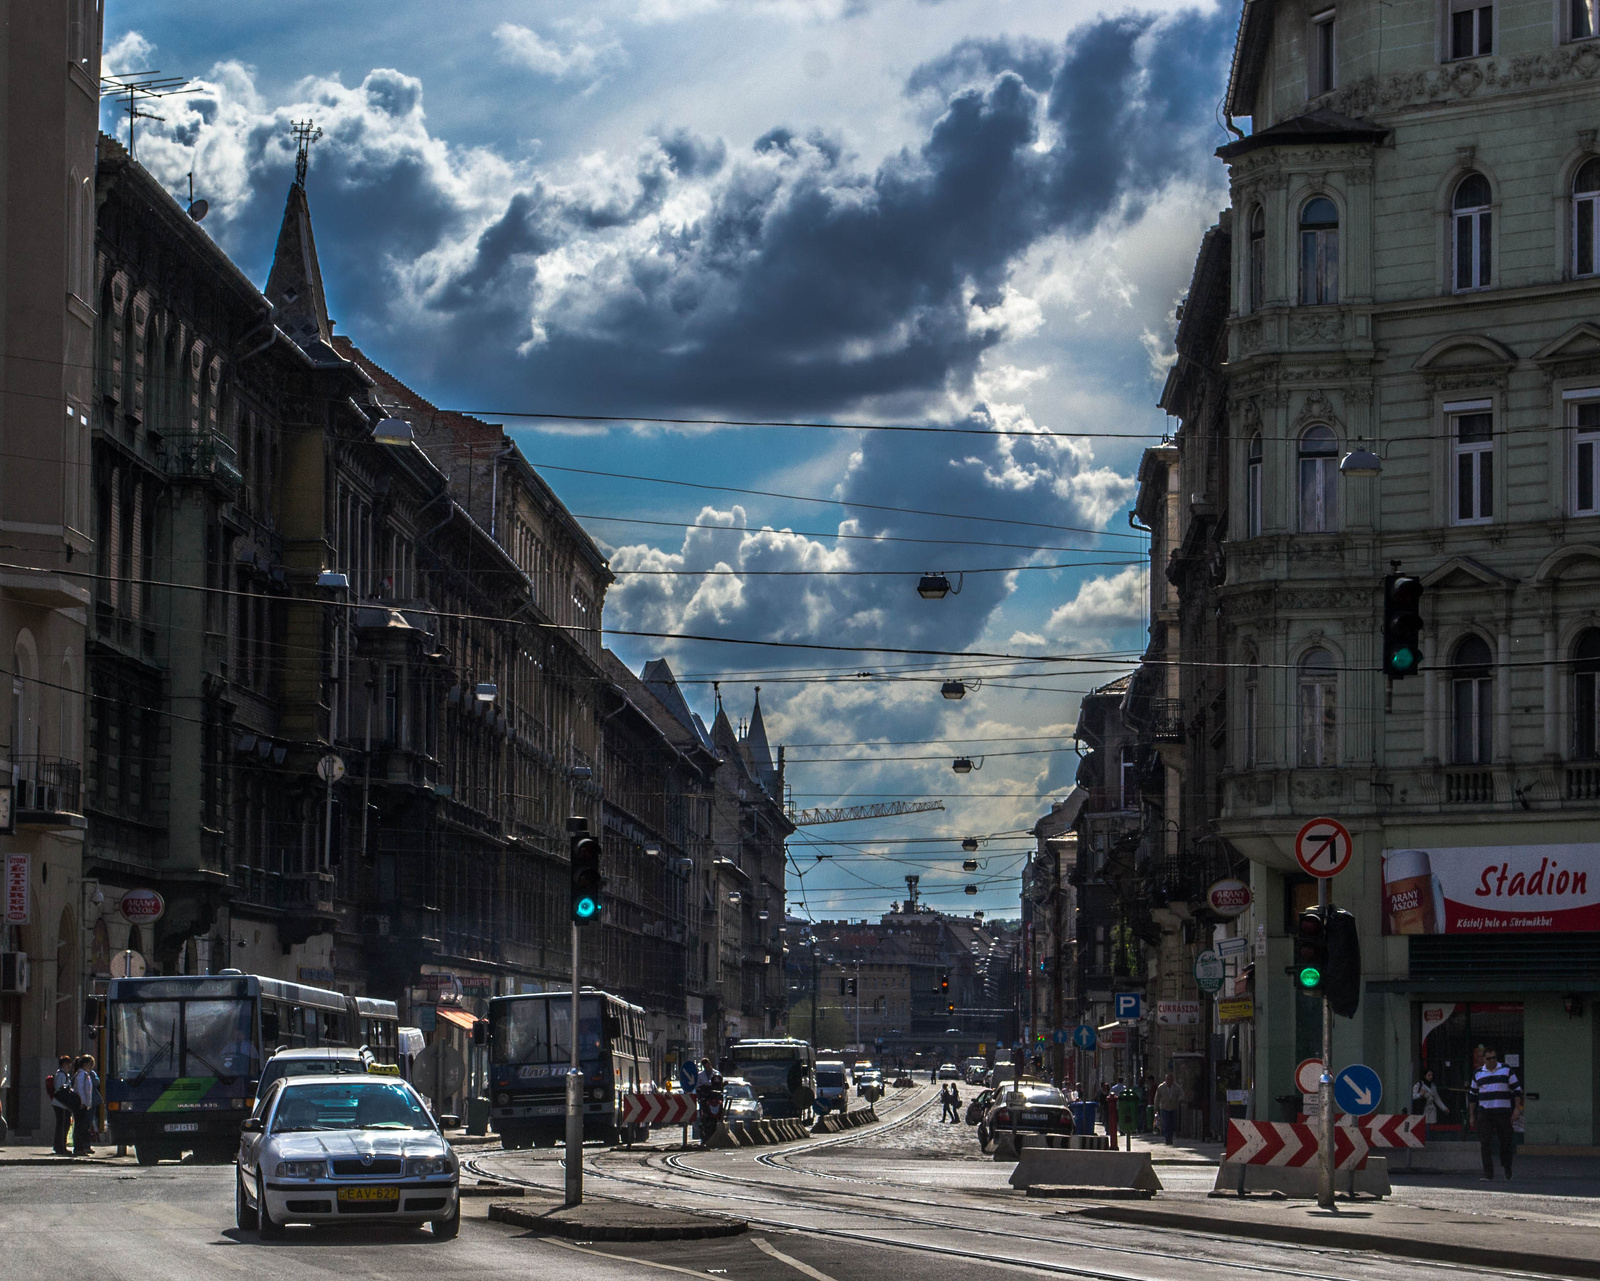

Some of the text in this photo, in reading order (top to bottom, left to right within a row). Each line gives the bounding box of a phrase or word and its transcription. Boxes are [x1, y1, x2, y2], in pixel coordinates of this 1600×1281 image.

[1475, 857, 1587, 897] Stadion
[1217, 890, 1245, 898] ARANY
[1391, 890, 1419, 904] ARANY
[127, 899, 156, 908] ARANY
[1456, 916, 1553, 930] Kóstolj bele a Sörömökbe!
[1120, 996, 1136, 1015] P
[1158, 1002, 1198, 1013] CUKRÁSZDA
[519, 1065, 571, 1079] LAPTO
[347, 1188, 397, 1199] EAV-627
